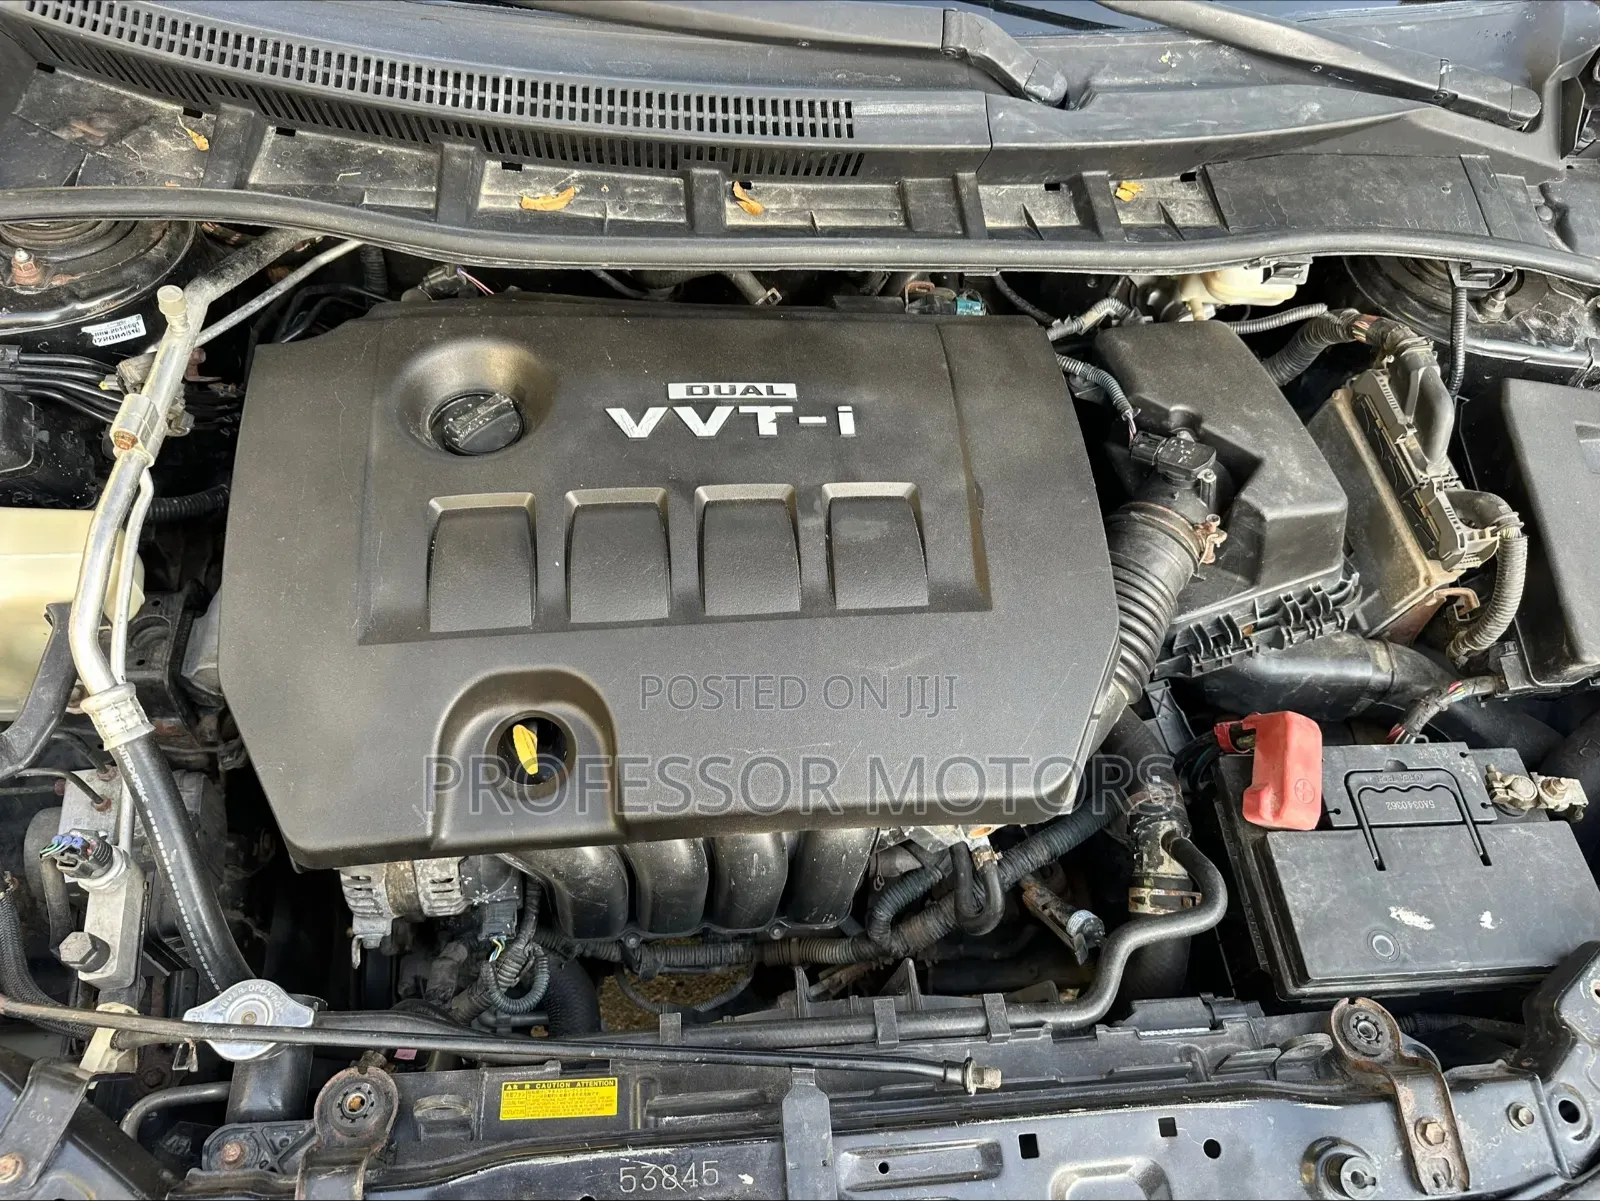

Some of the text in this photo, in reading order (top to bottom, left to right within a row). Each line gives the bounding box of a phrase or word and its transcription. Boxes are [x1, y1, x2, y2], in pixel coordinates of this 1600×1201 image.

[683, 384, 788, 397] DUAL
[605, 405, 856, 438] VVT-i
[535, 1082, 571, 1090] CAUTION
[576, 1080, 614, 1088] ATTENTION
[619, 1160, 719, 1193] 53845
